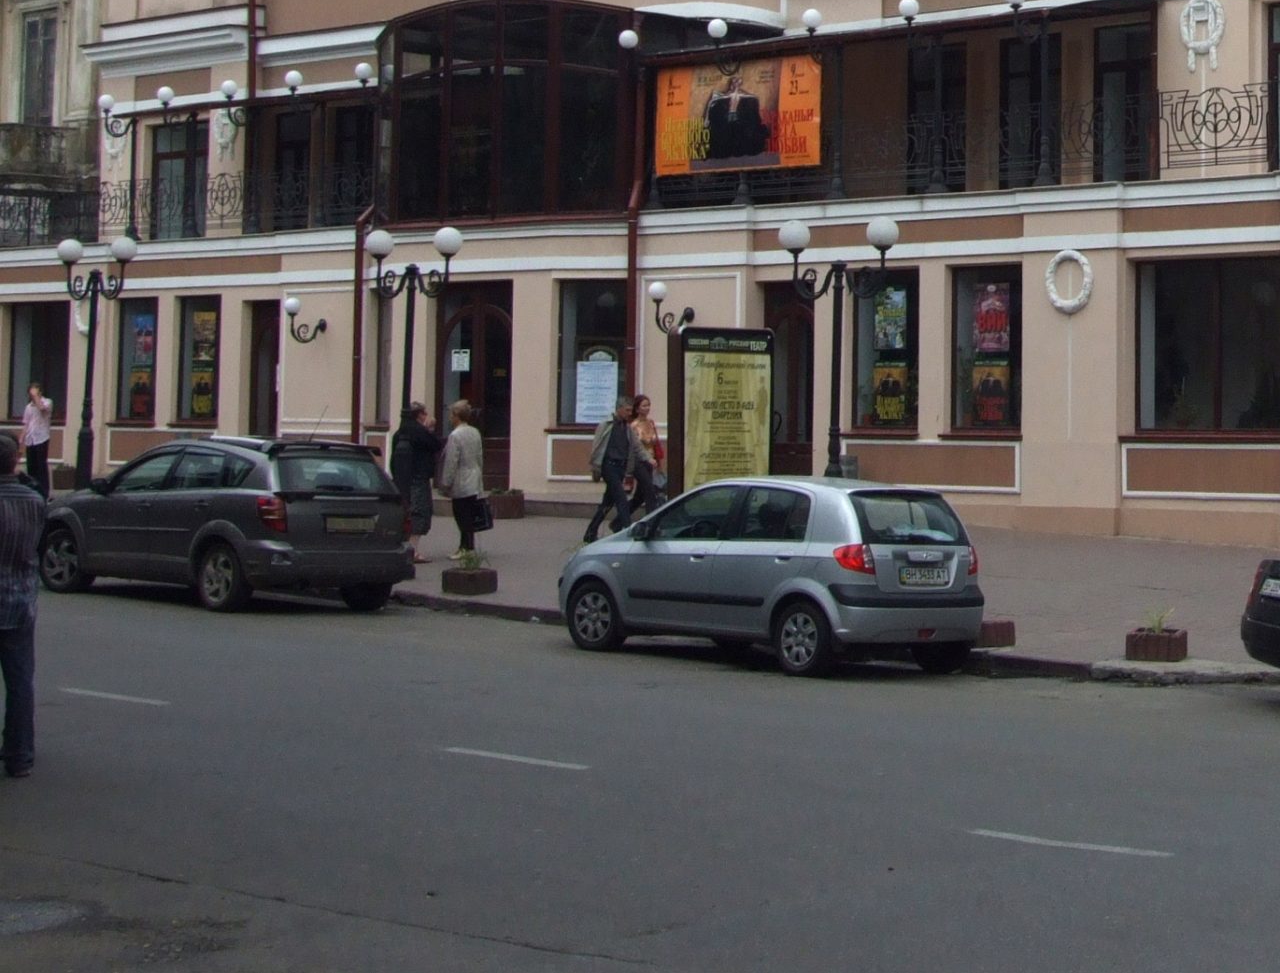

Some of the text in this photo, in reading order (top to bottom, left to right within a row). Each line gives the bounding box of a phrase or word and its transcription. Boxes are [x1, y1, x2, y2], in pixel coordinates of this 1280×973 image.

[761, 108, 814, 126] АКАНЬИ
[716, 371, 724, 385] 6
[937, 569, 946, 580] AT
